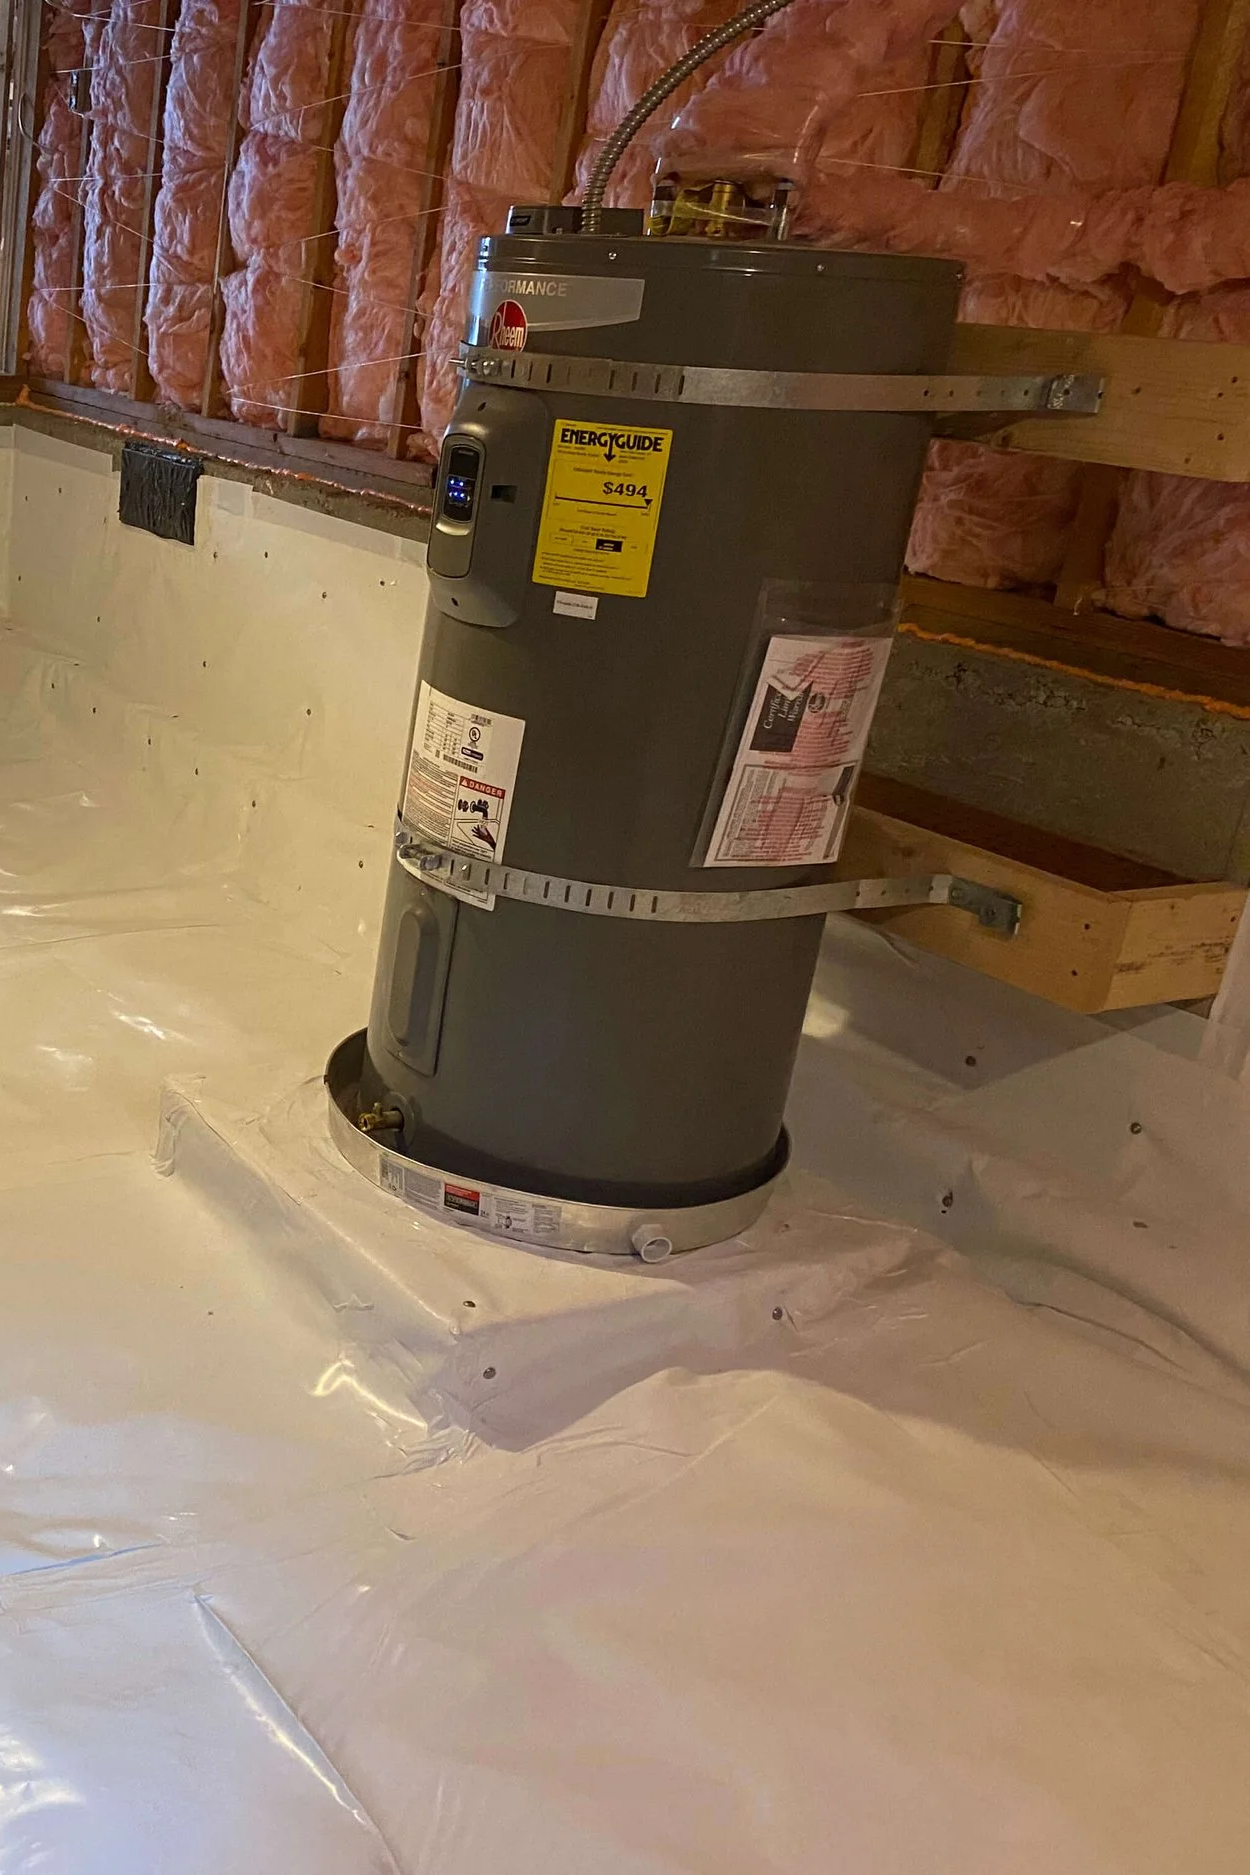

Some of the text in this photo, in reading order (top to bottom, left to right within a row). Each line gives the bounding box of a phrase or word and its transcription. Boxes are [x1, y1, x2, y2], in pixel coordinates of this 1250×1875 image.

[490, 304, 524, 350] Rheem
[560, 428, 664, 453] ENERGYGUIDE
[602, 481, 648, 498] $494
[469, 781, 502, 797] DANGER
